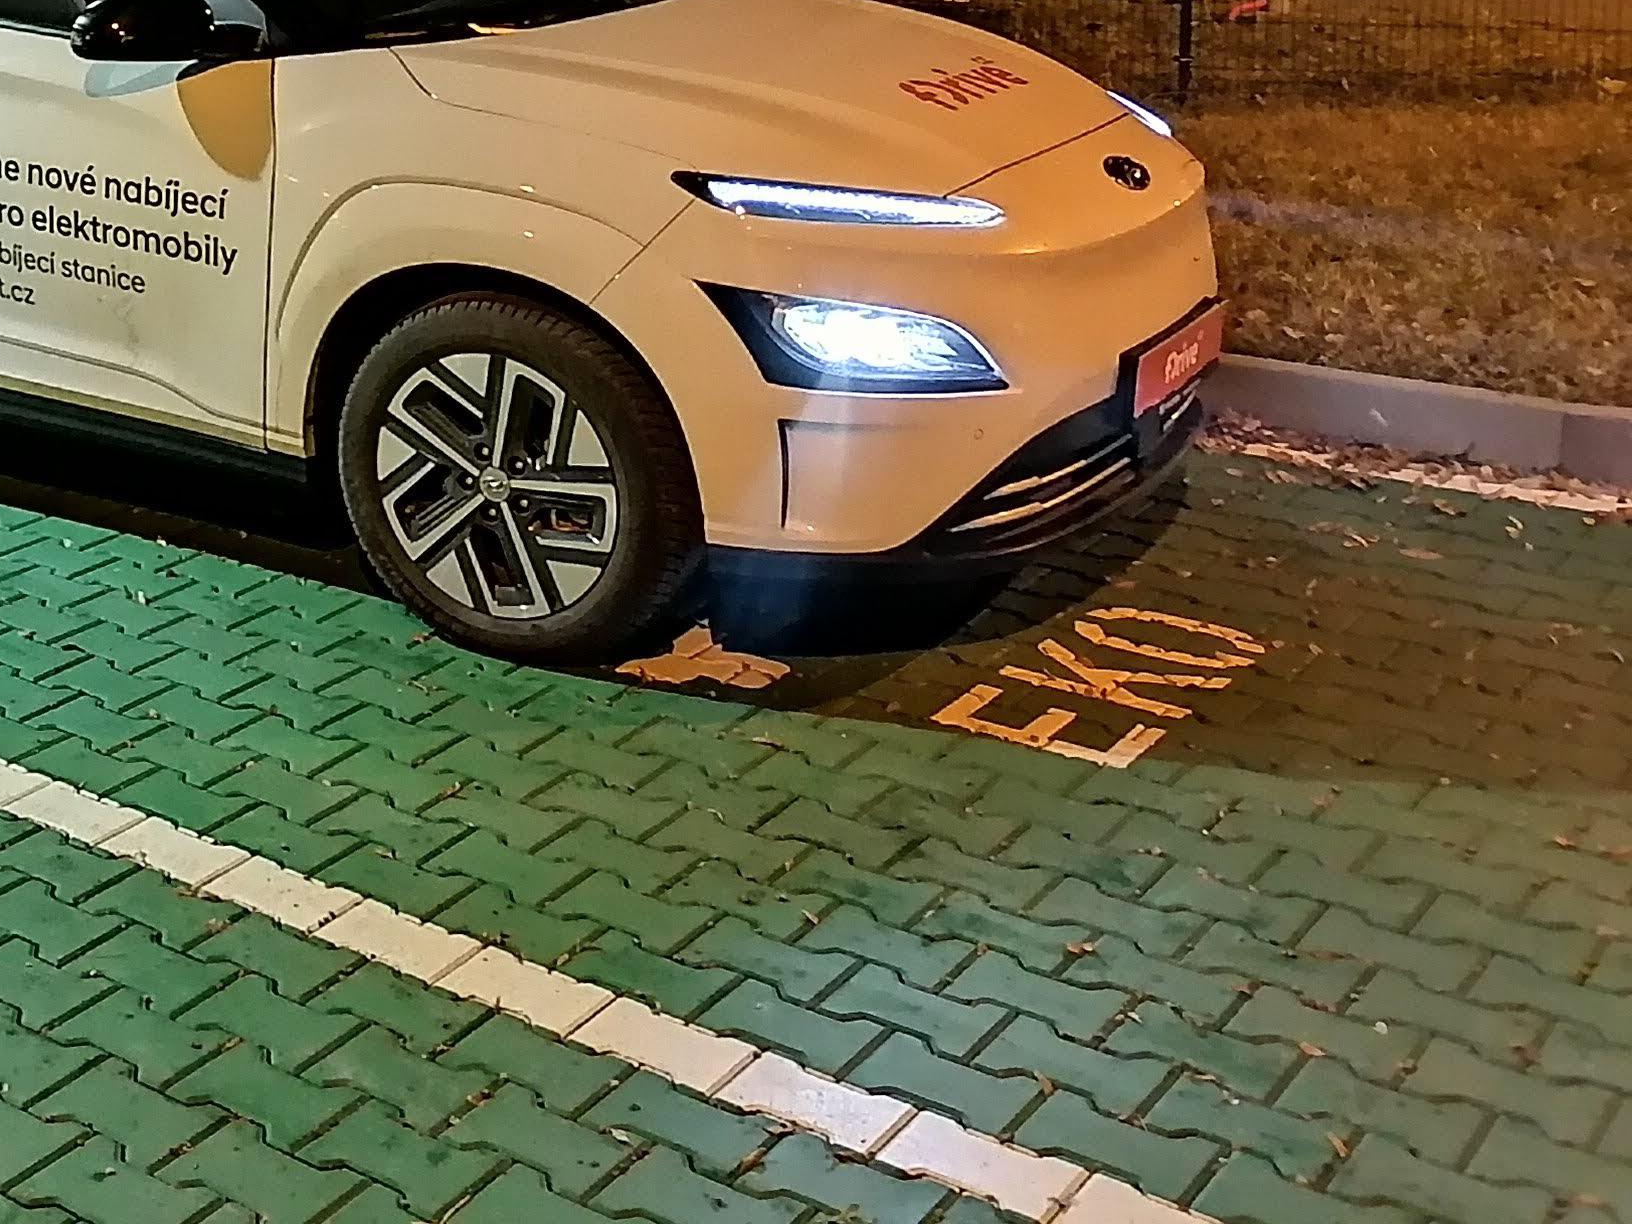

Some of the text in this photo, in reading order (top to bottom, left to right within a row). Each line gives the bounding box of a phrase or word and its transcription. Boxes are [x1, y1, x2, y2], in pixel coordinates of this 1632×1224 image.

[27, 164, 97, 196] nové
[104, 176, 229, 220] nabíjecí
[31, 204, 238, 276] elektromobily
[60, 258, 146, 294] stanice
[930, 607, 1267, 769] EKO
